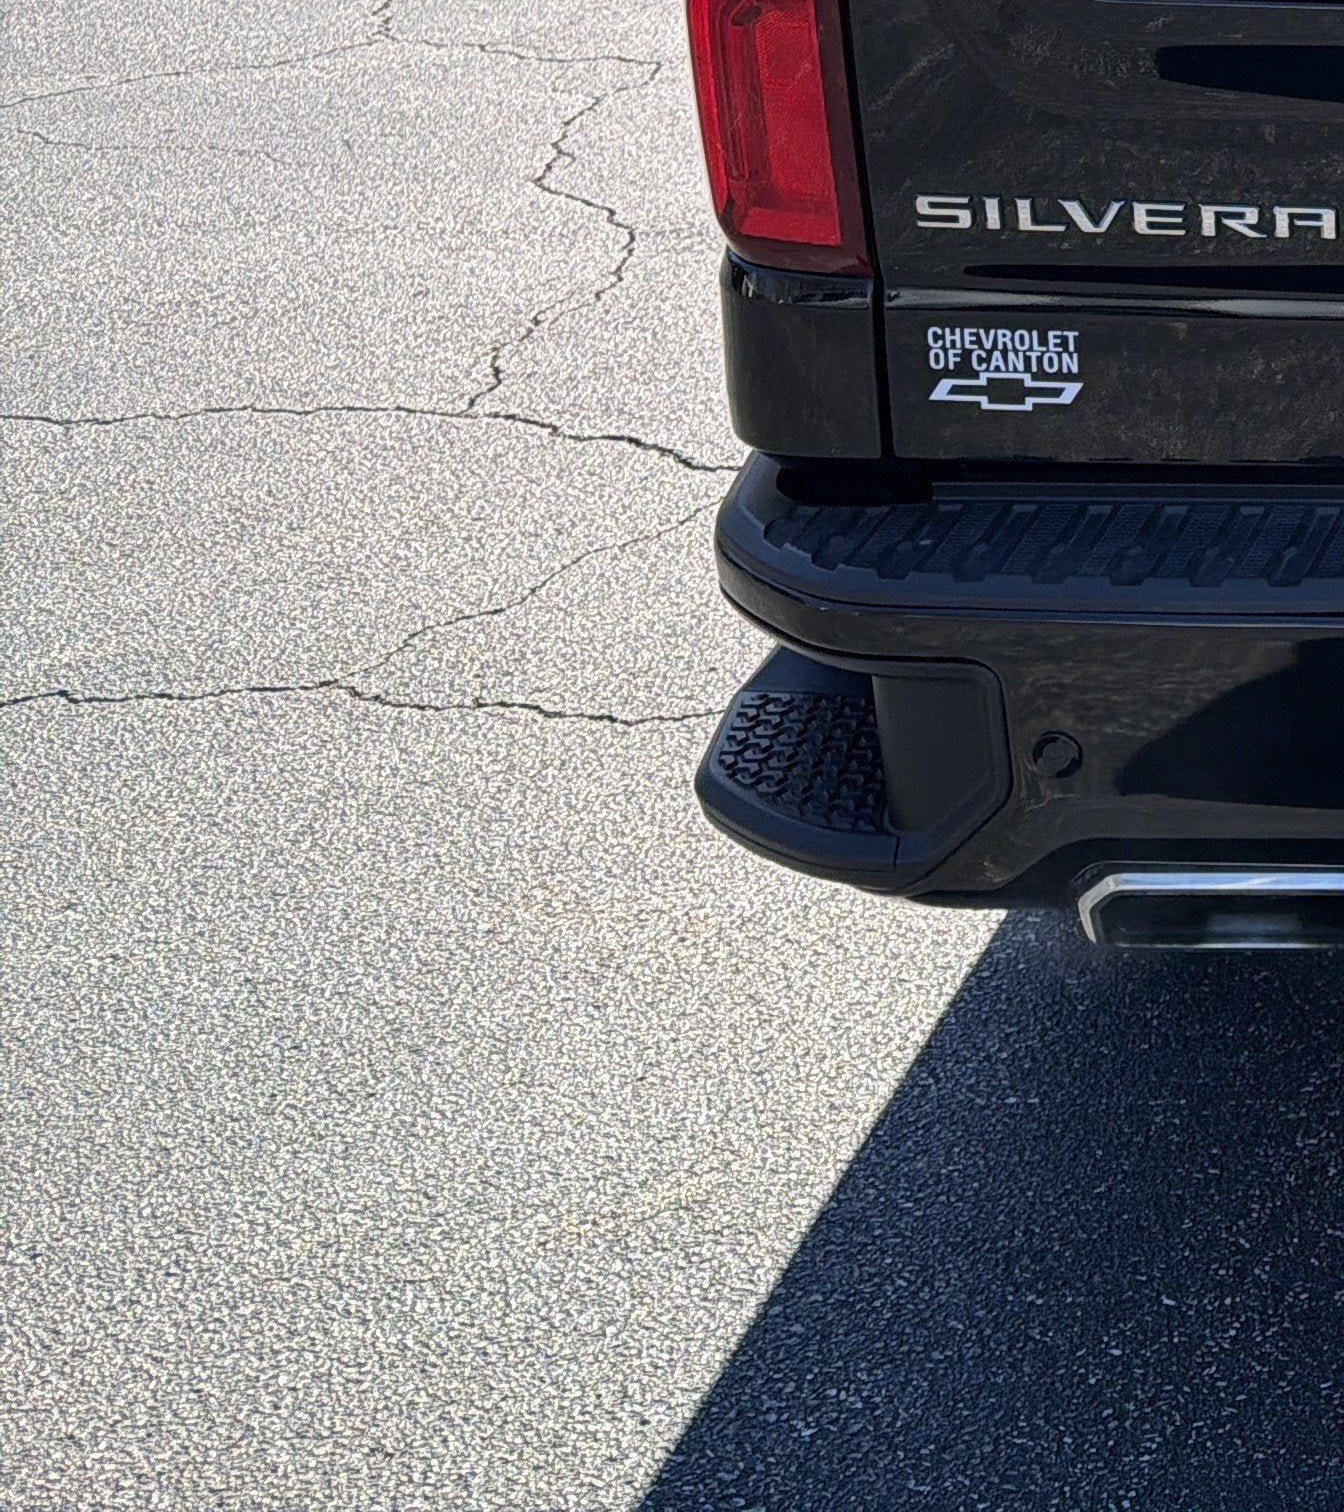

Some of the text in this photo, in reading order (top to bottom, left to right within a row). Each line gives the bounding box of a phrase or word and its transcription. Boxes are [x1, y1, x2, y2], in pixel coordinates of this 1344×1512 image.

[926, 326, 1080, 353] CHEVROLET
[928, 348, 1080, 374] OF CANTON
